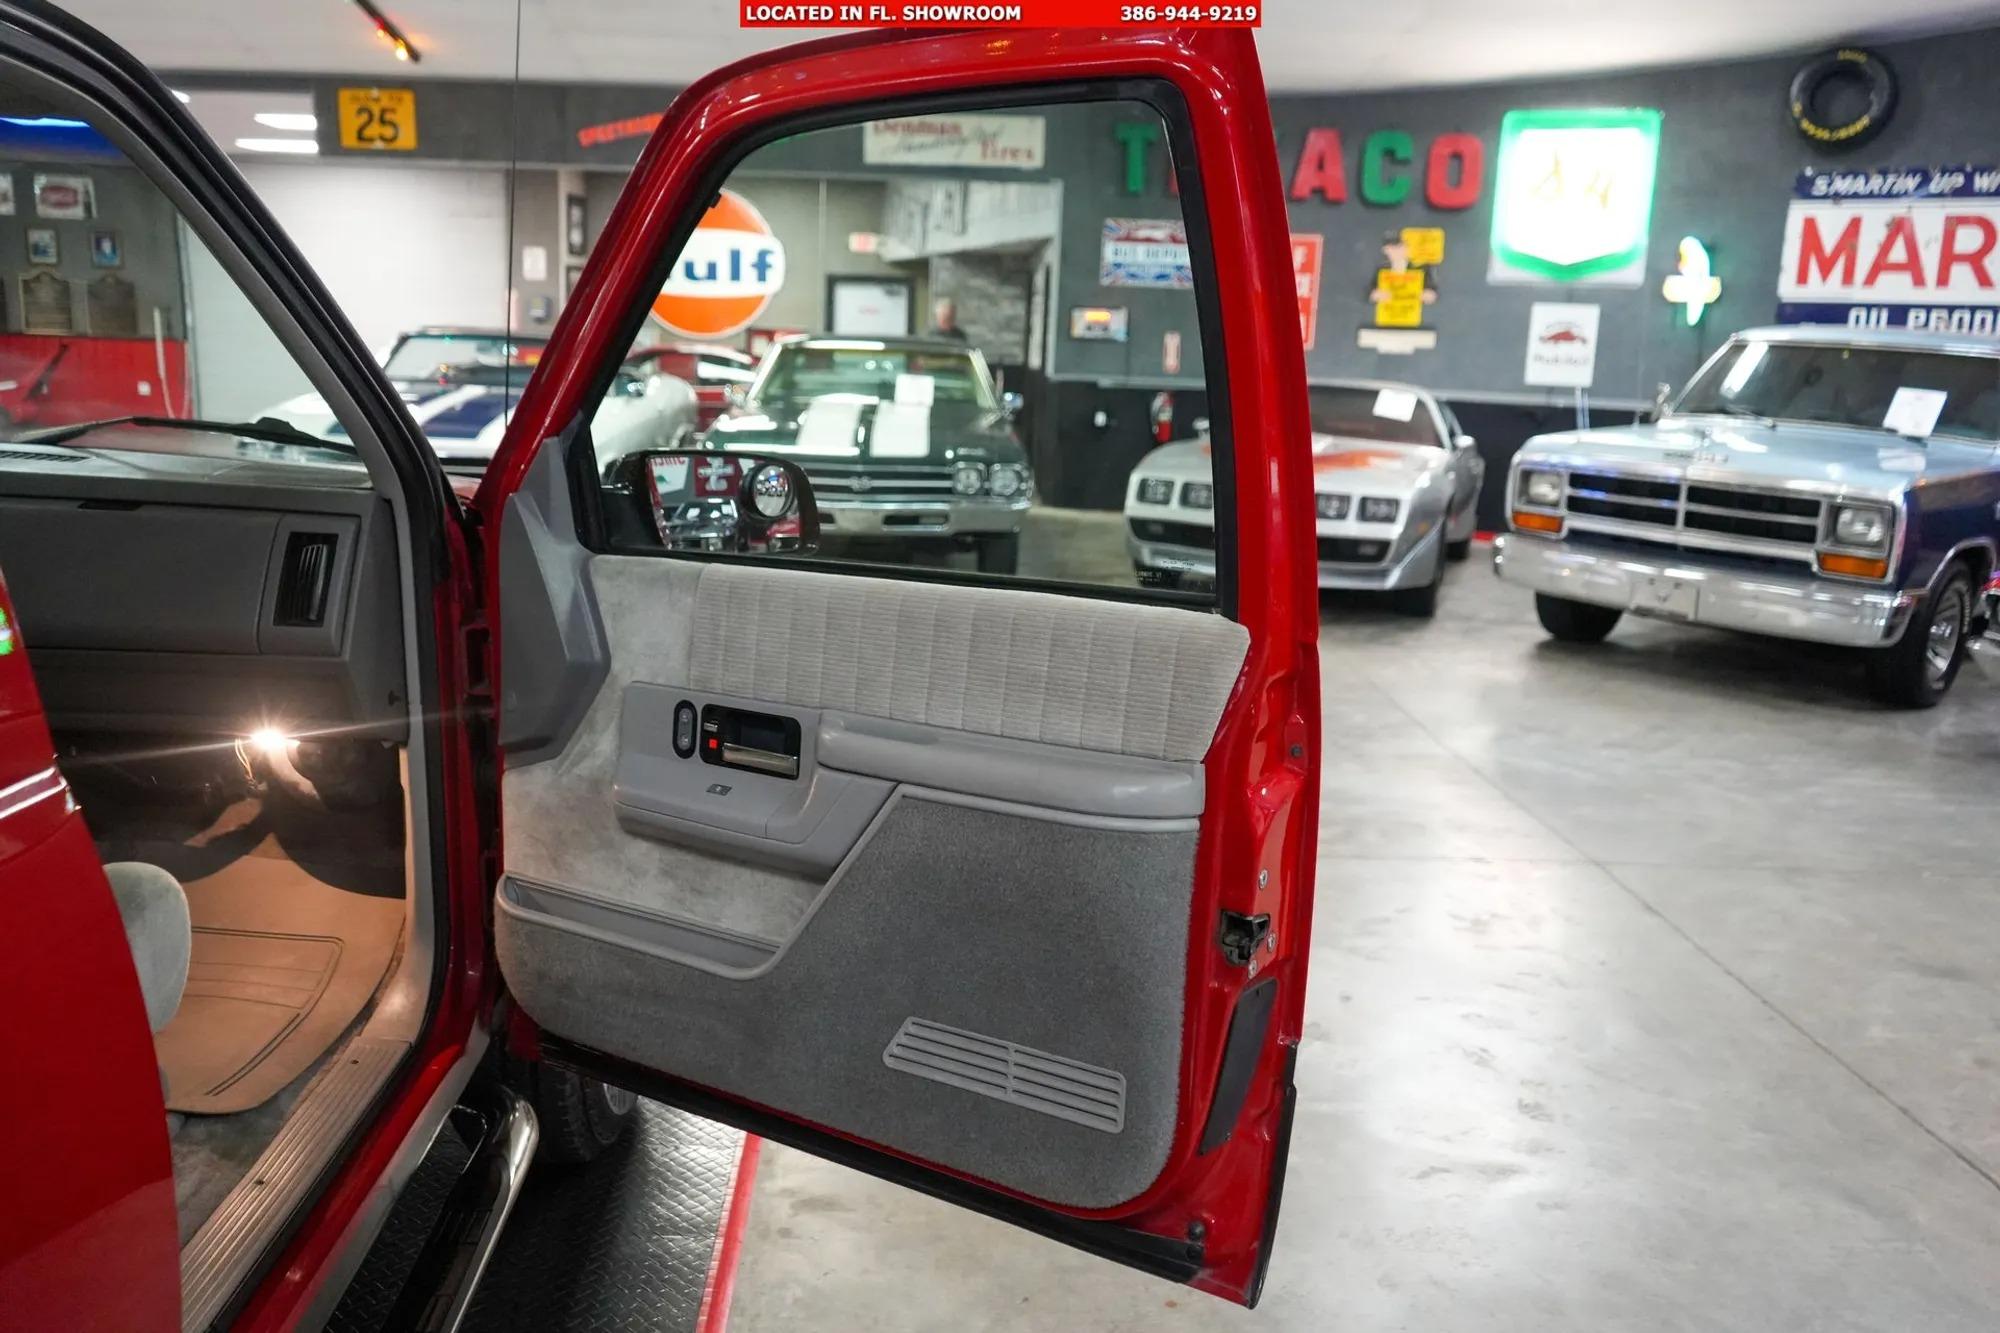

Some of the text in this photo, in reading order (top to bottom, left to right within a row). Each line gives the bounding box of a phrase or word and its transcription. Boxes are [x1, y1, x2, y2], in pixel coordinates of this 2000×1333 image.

[355, 107, 399, 144] 25
[1114, 120, 1485, 209] TACO
[667, 248, 774, 282] ulf
